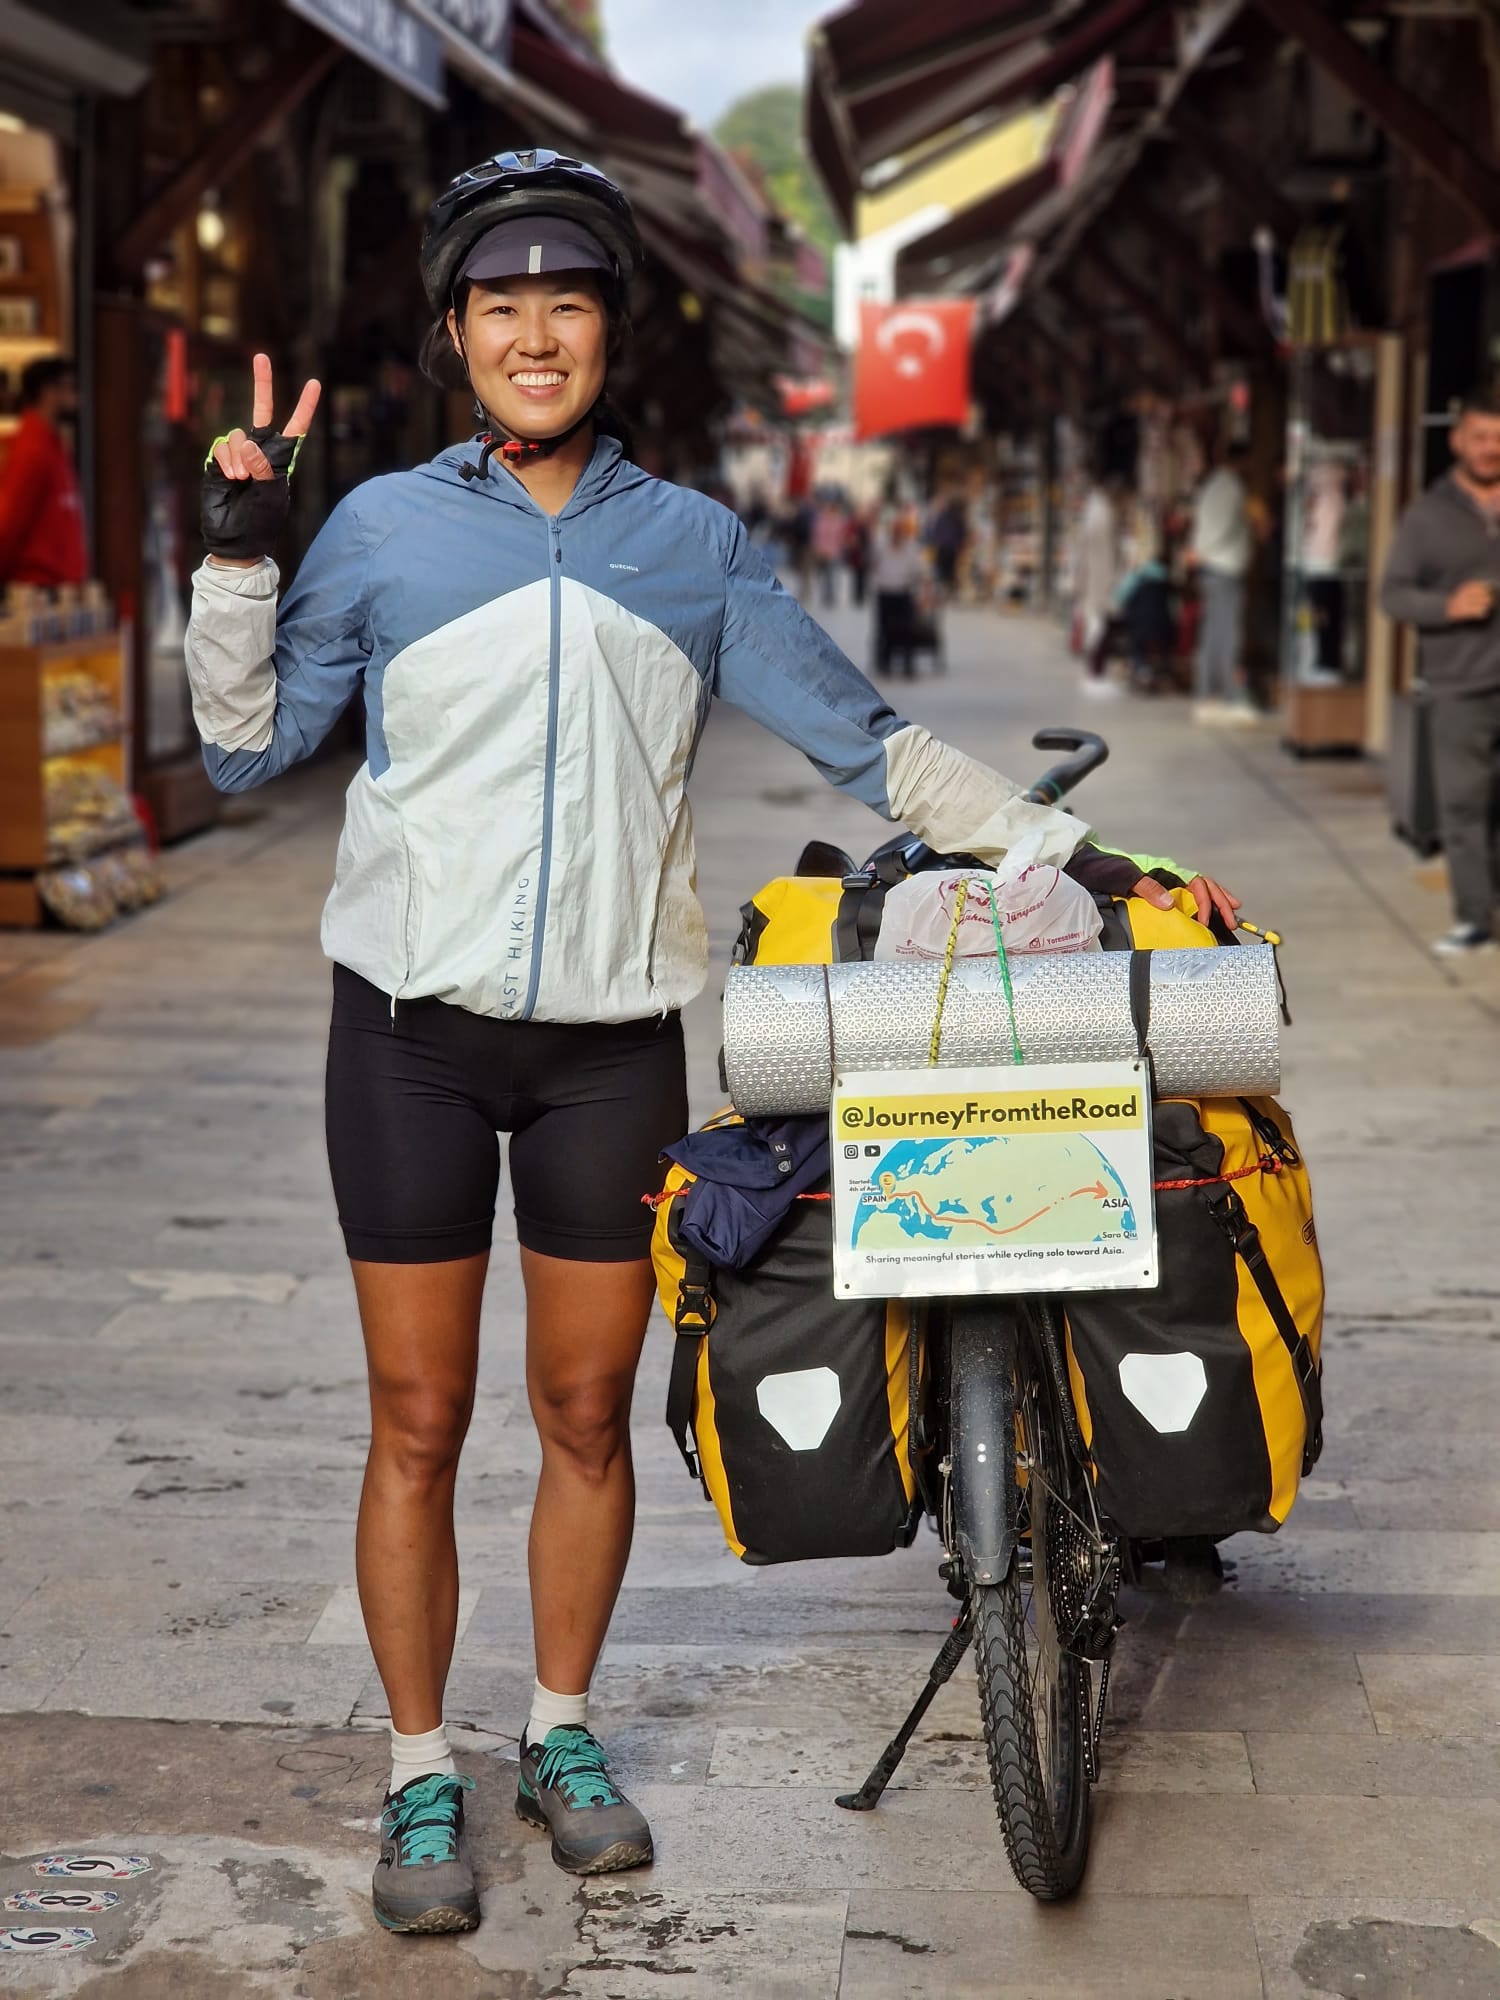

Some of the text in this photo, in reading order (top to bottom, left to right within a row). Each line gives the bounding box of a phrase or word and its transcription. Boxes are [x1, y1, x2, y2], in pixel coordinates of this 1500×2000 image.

[507, 877, 530, 960] HIKING
[842, 1095, 1137, 1130] @JourneyFromtheRoad
[866, 1185, 880, 1193] April
[862, 1195, 887, 1203] SPAIN
[1102, 1198, 1130, 1208] ASIA
[1102, 1230, 1137, 1239] Sara Qiu
[865, 1246, 1125, 1264] Sharing meaningful stories while cycling solo toward Asia.
